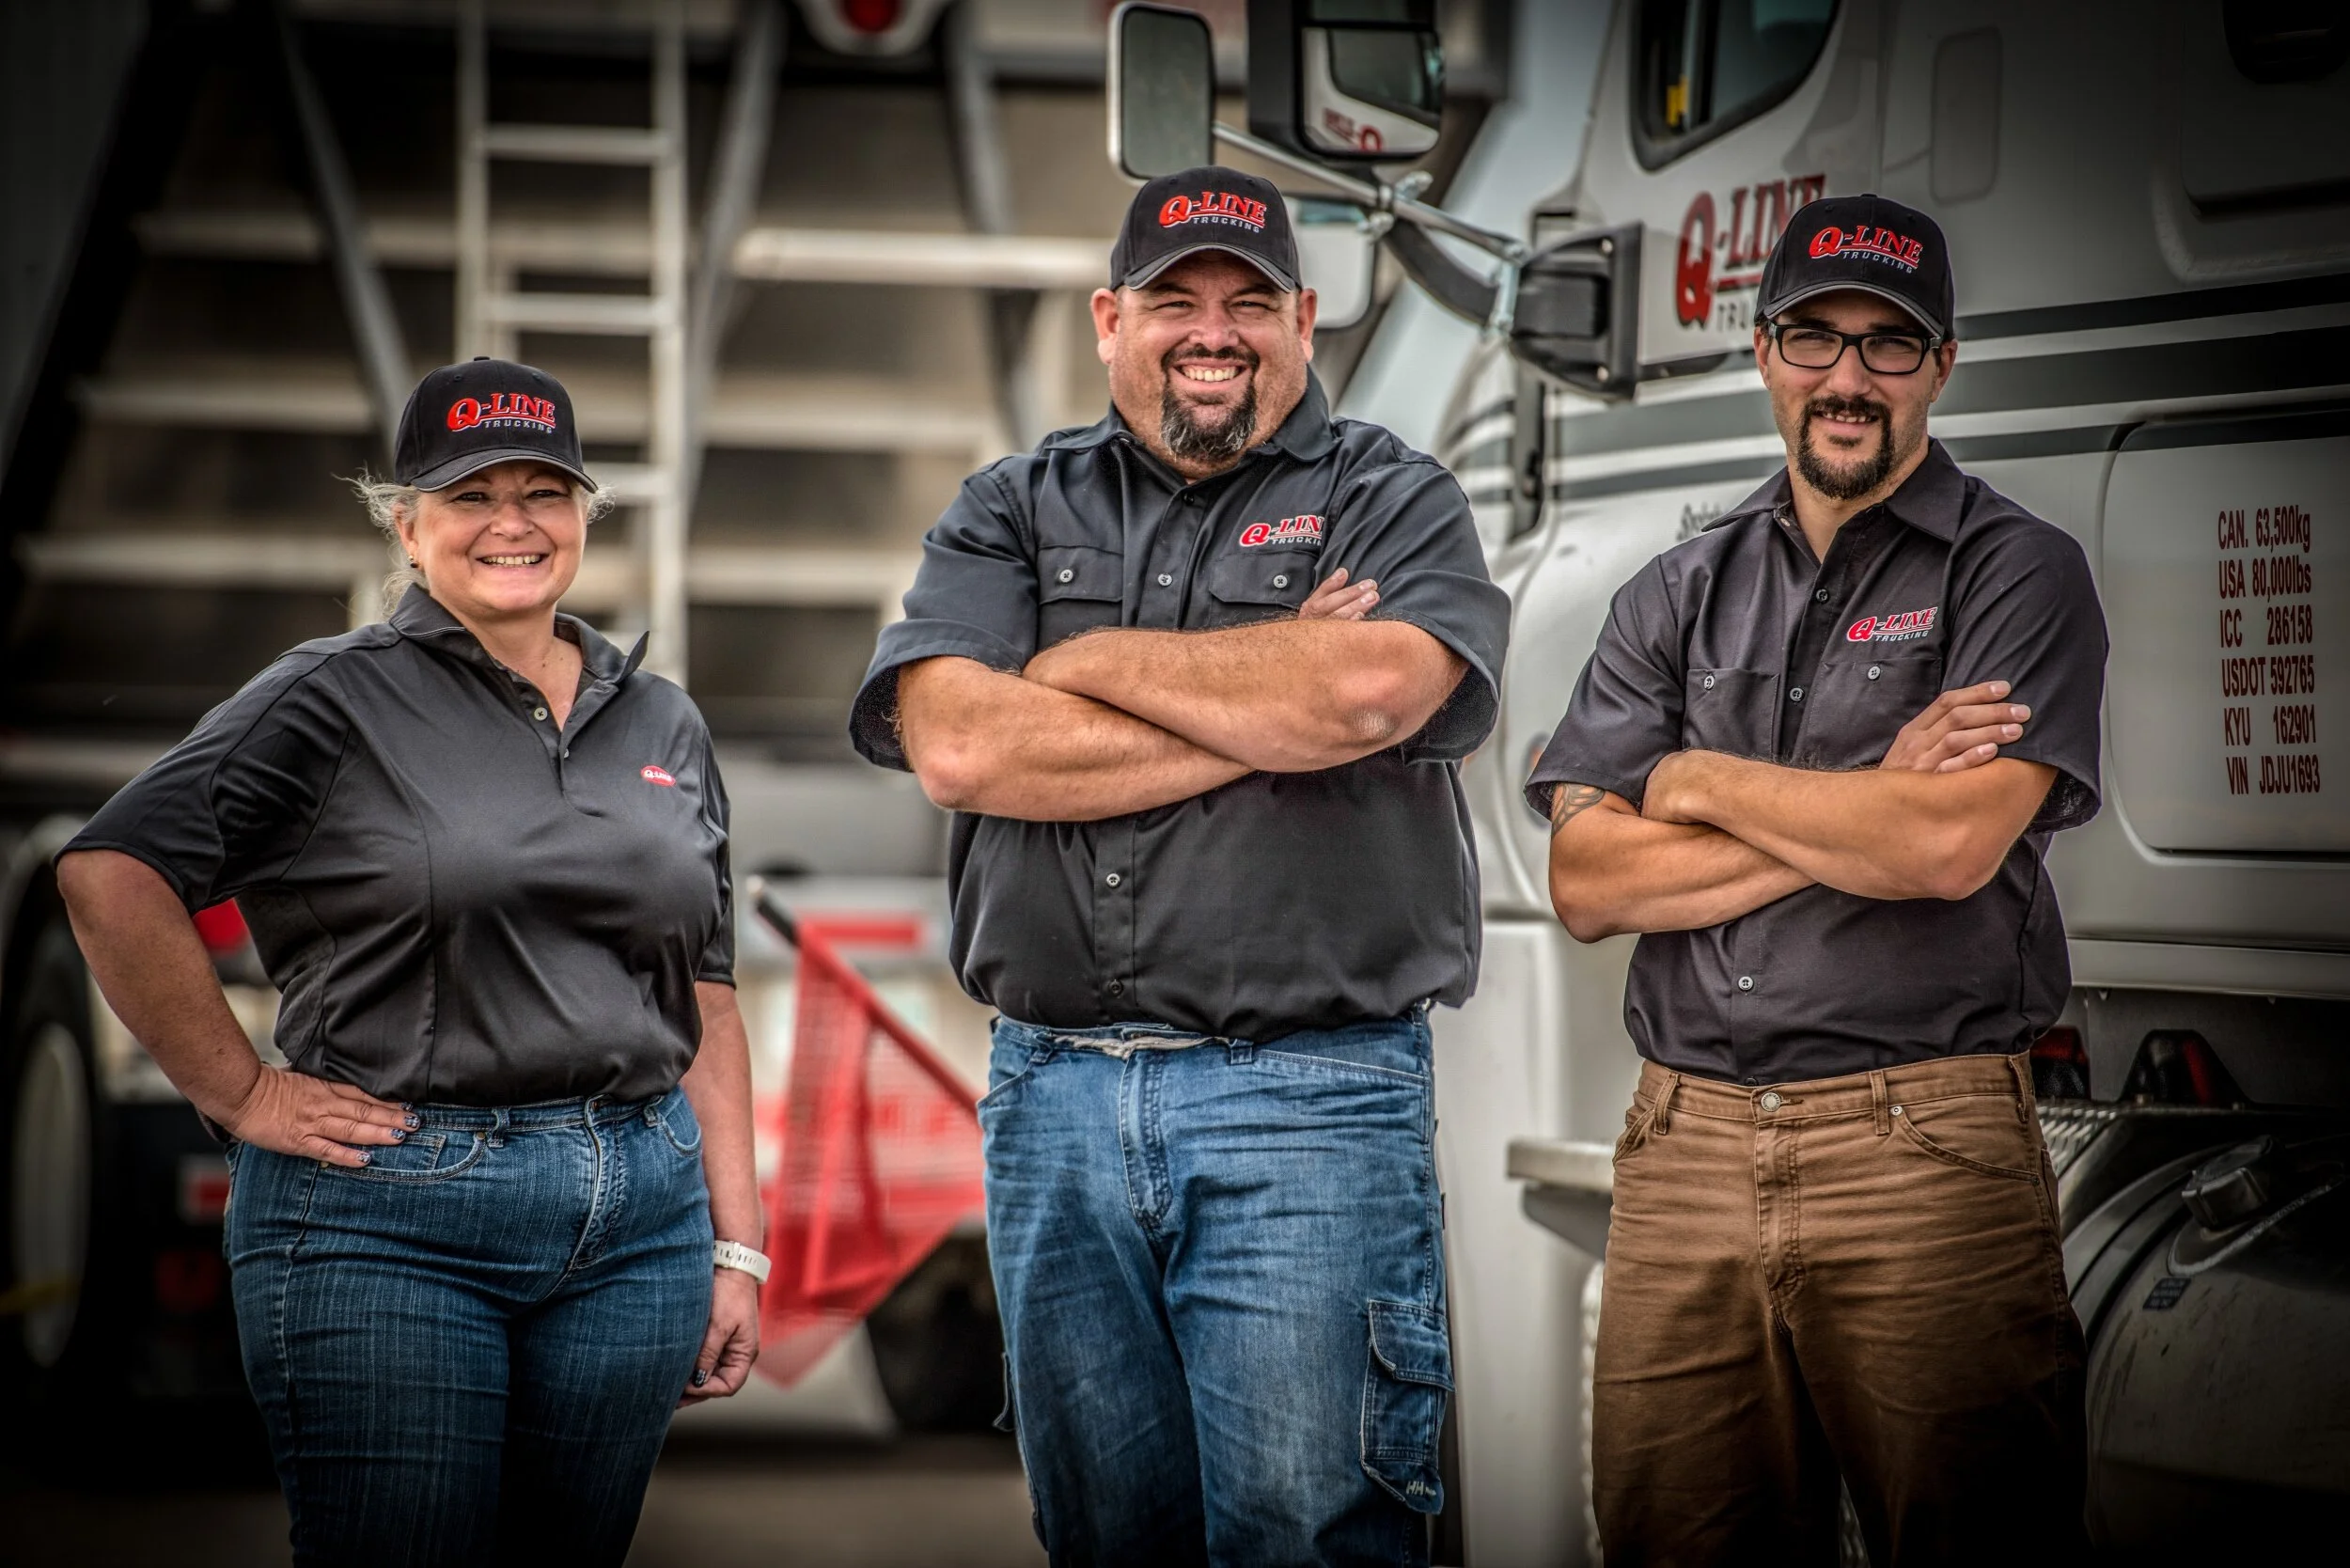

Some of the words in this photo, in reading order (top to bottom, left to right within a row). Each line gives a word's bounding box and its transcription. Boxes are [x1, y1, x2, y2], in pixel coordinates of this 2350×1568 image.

[1159, 192, 1267, 228] Q-LINE
[1193, 216, 1260, 233] TRUCKING
[1809, 225, 1923, 268] Q-LINE
[1842, 251, 1913, 274] TRUCKING
[446, 392, 556, 431] Q-LINE
[484, 419, 553, 434] TRUCKING
[1239, 515, 1324, 547] Q-LIN
[1272, 536, 1322, 546] TRUCKI
[2218, 510, 2248, 550] CAN.
[2256, 505, 2311, 553] 63,500kg
[2219, 559, 2246, 600] USA
[2252, 556, 2311, 603] 80,000lbs
[1847, 606, 1938, 642] Q-LINE
[1875, 630, 1929, 642] TRUCKING
[2220, 609, 2243, 648] ICC
[2267, 604, 2312, 645] 286158
[2222, 657, 2266, 698] USDOT
[2270, 655, 2314, 695] 592765
[2224, 707, 2251, 746] KYU
[2273, 704, 2316, 745] 162901
[2226, 757, 2248, 794] VIN
[2260, 755, 2320, 793] JDJU1693
[1405, 1481, 1424, 1496] HH
